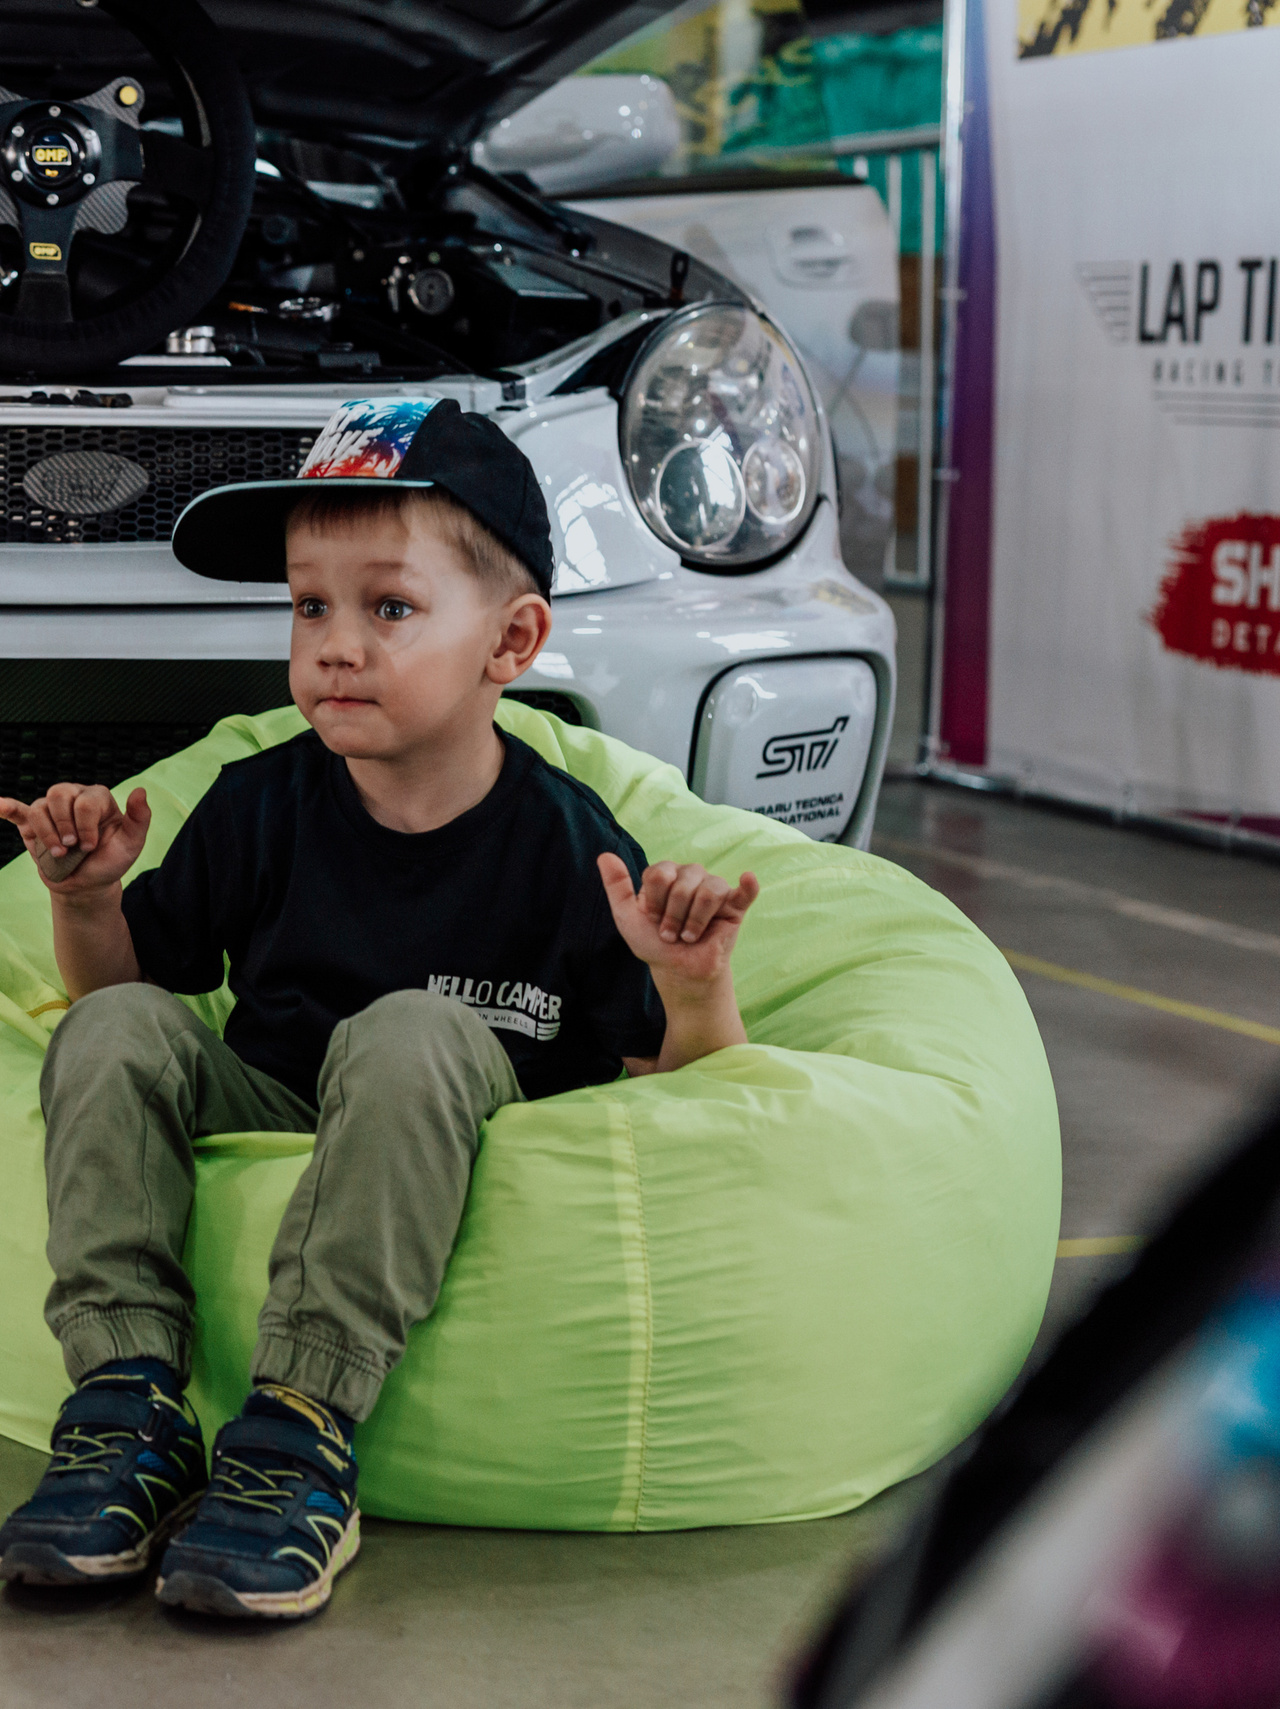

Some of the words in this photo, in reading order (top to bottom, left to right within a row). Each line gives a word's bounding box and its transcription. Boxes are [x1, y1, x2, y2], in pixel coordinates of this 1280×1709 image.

[35, 148, 68, 162] OMP
[1139, 260, 1221, 343] LAP
[1238, 257, 1280, 343] TI
[1211, 540, 1280, 612] SH
[496, 980, 562, 1020] CAMPER
[493, 1015, 528, 1029] WHEELS
